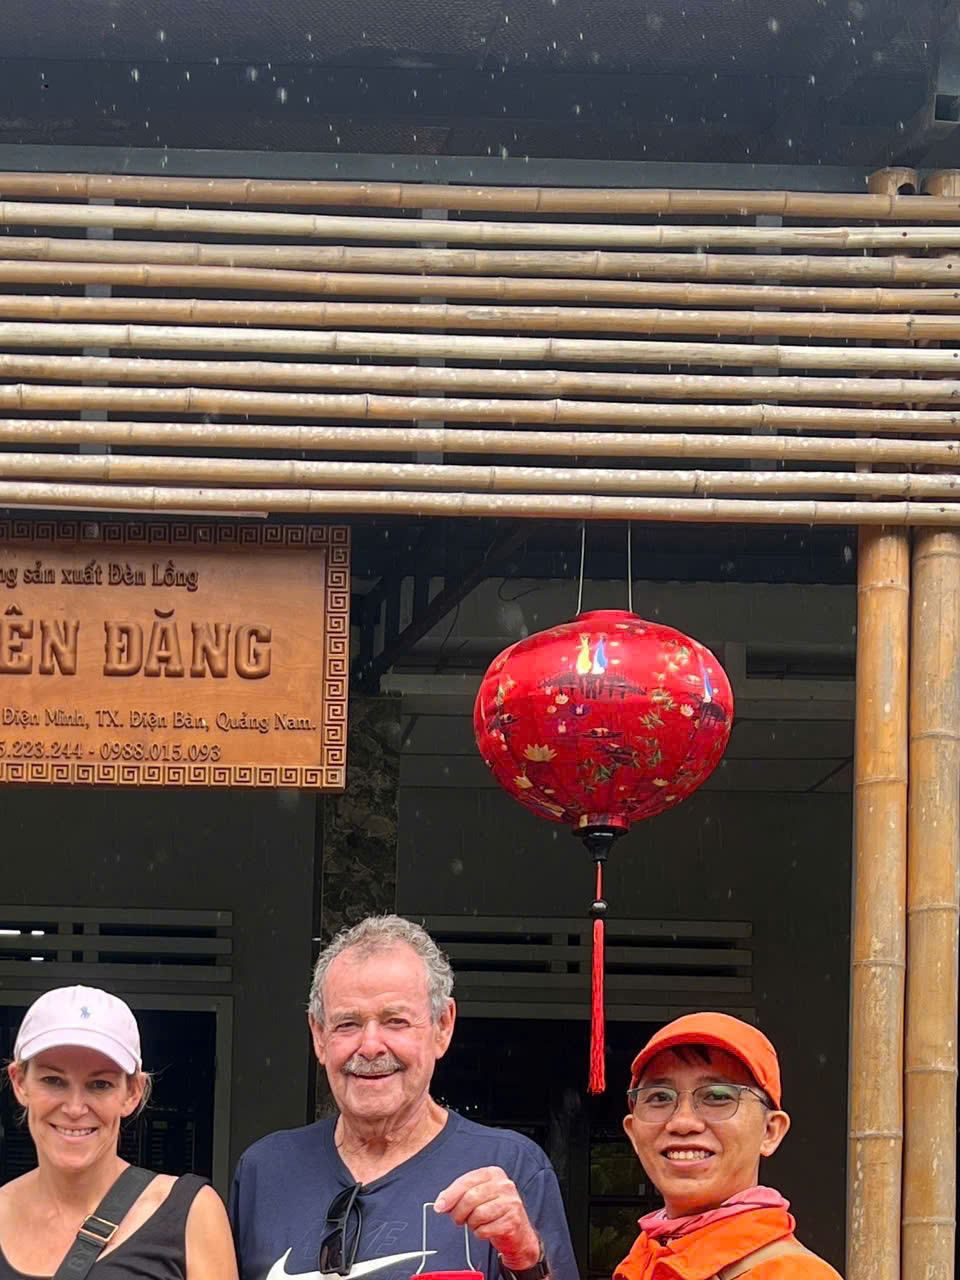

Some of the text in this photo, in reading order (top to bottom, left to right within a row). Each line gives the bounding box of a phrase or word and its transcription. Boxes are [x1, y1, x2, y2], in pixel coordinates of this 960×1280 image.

[23, 560, 56, 585] sản
[61, 560, 103, 586] xuất
[108, 562, 147, 587] Đèn
[152, 560, 199, 592] Lồng
[103, 608, 273, 680] ĐĂNG
[2, 707, 41, 730] Điện
[95, 710, 124, 729] TX.
[129, 710, 168, 732] Điện
[173, 711, 210, 732] Bàn,
[216, 711, 270, 734] Quảng
[274, 712, 317, 731] Nam.
[99, 742, 222, 762] 0988.015.093
